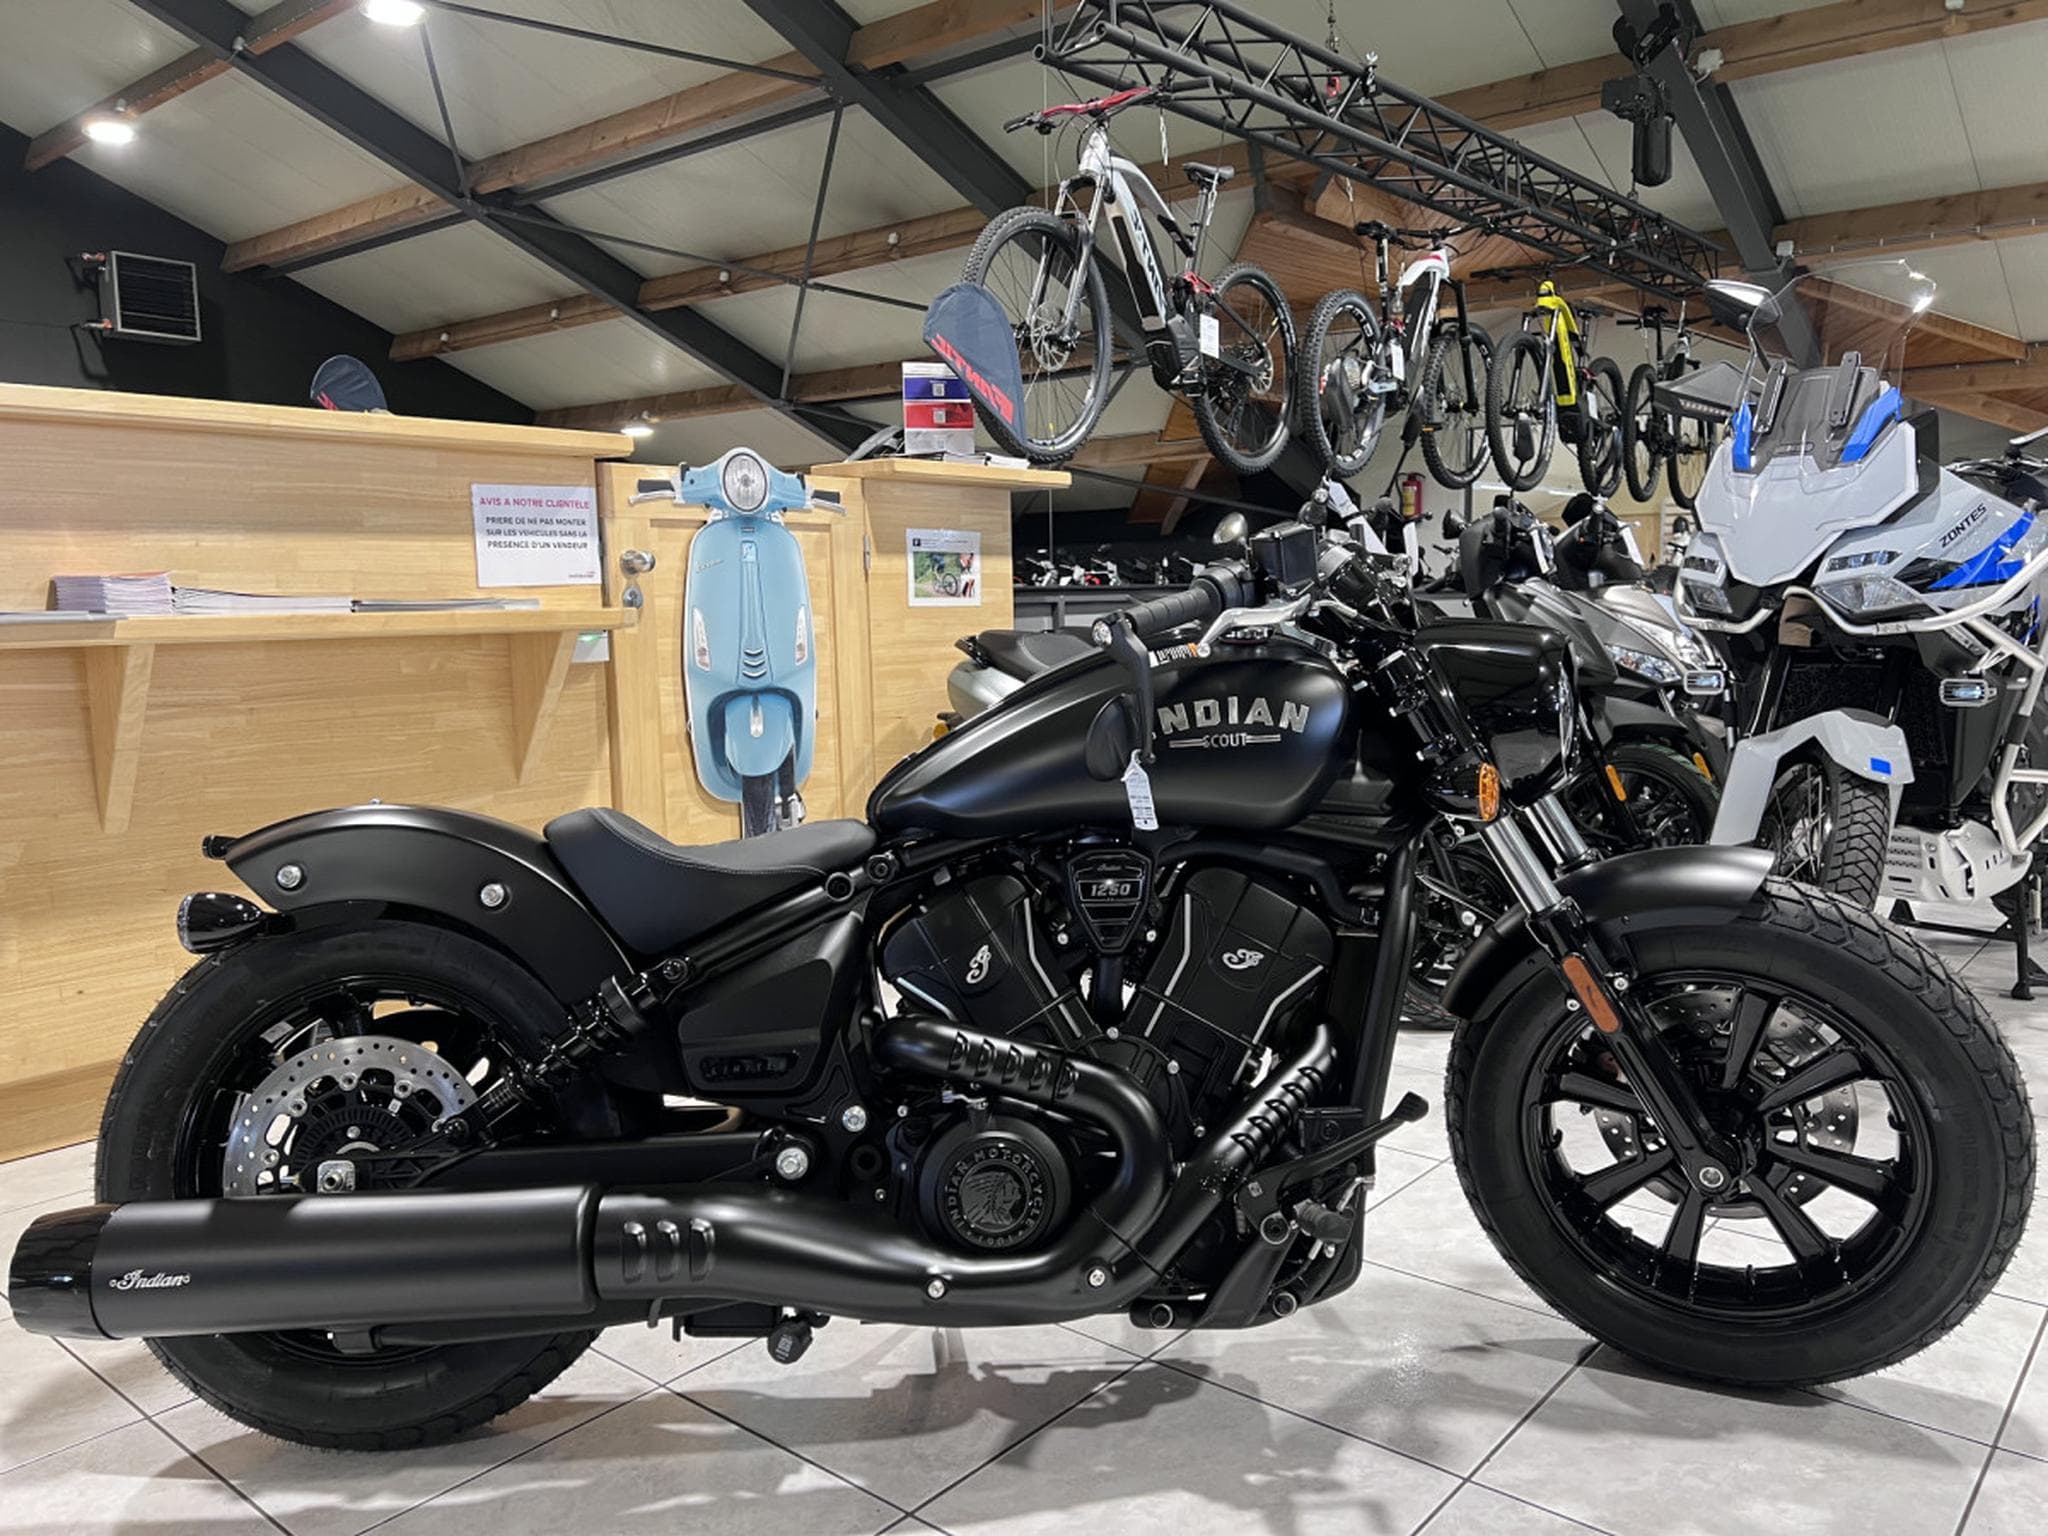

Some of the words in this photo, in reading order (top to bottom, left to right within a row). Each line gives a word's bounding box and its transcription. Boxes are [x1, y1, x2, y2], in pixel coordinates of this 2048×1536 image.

[480, 497, 501, 506] AVIS
[513, 498, 543, 508] NOTRE
[486, 516, 513, 526] PRIERE
[515, 516, 525, 526] DE
[527, 517, 537, 526] NE
[540, 517, 554, 526] PAS
[556, 517, 586, 527] MONTER
[1939, 502, 1987, 548] ZONTES
[486, 529, 502, 537] SUR
[503, 529, 517, 537] LES
[559, 530, 577, 538] SANS
[578, 530, 588, 538] LA
[487, 540, 530, 549] PRESENCE
[531, 541, 551, 549] D'UN
[552, 541, 588, 550] VENDEUR
[1152, 696, 1310, 739] NDIAN
[1202, 732, 1249, 748] SCOUT
[1090, 883, 1132, 897] 1250
[944, 1160, 969, 1229] INDIAN
[974, 1148, 1043, 1228] MOTORCYCLE
[115, 1269, 185, 1291] Indian
